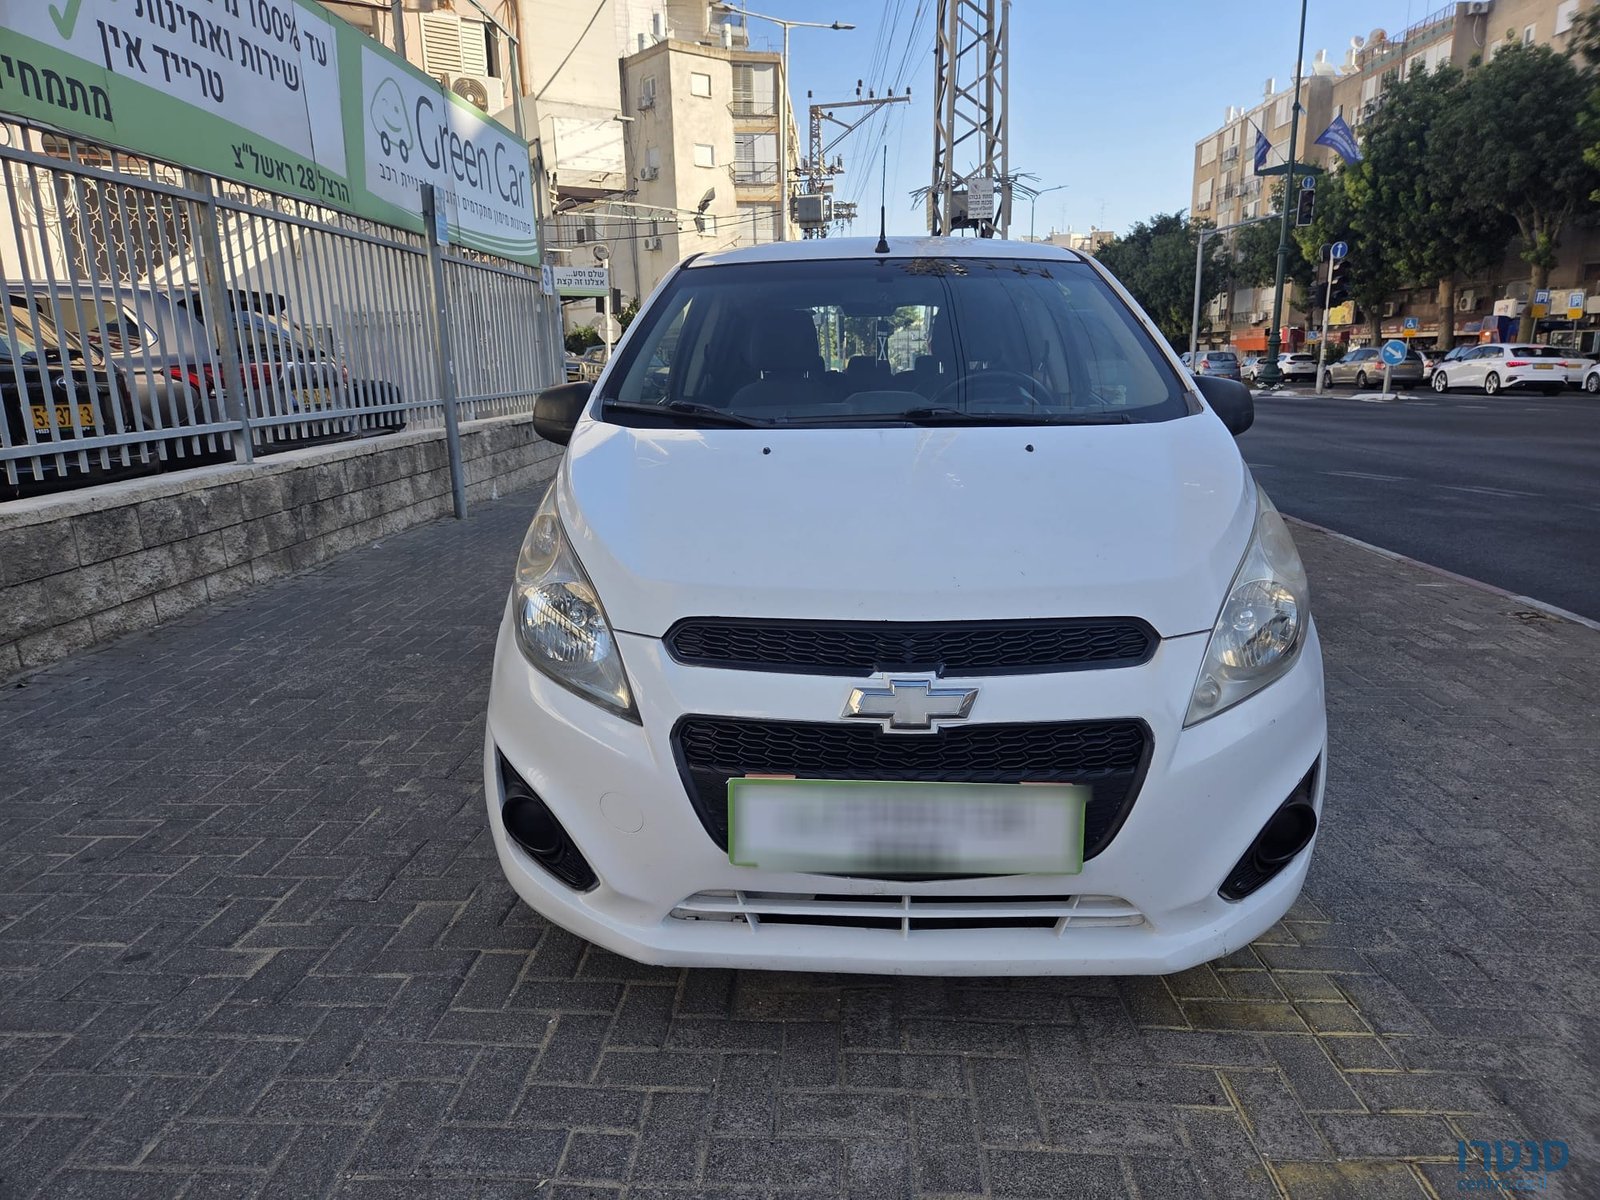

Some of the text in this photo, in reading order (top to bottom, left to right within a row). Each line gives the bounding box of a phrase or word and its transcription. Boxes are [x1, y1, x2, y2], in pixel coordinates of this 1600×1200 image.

[135, 0, 299, 92] שירות ואמינות
[249, 0, 300, 52] 100%
[304, 30, 327, 67] עד
[96, 19, 224, 103] טרייד אין
[0, 54, 114, 122] מתמחי
[297, 164, 316, 192] 28
[379, 162, 398, 184] רכב
[416, 95, 525, 209] Green Car
[316, 170, 350, 203] הרצל
